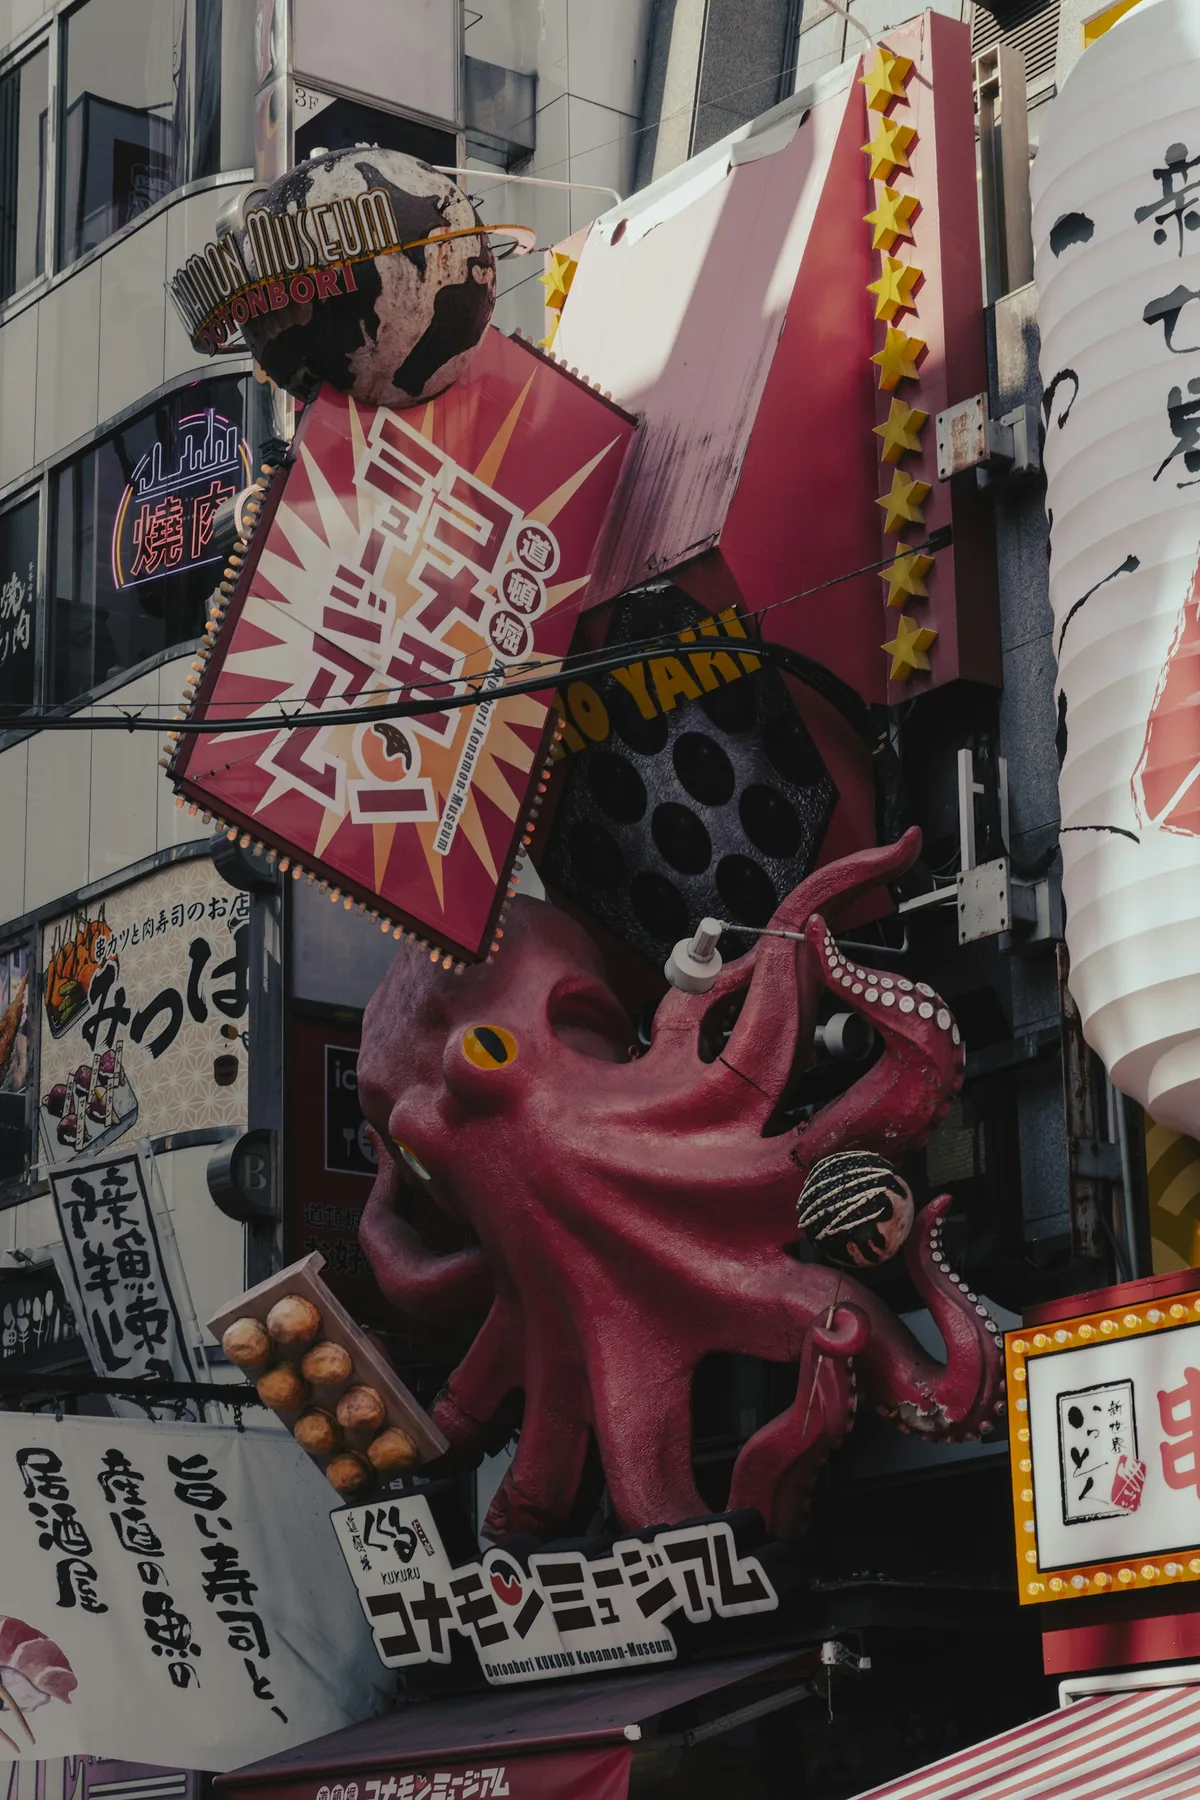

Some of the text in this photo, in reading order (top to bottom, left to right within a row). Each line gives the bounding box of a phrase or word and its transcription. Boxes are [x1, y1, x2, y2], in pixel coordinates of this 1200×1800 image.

[295, 88, 318, 109] 3F
[246, 187, 400, 278] MUSEUM
[202, 264, 358, 357] DOTONBORI
[267, 414, 448, 803] ミュージアム
[490, 528, 555, 657] 道頓堀
[352, 470, 519, 819] コナモン
[609, 608, 762, 721] YAKI
[436, 727, 485, 852] Konamon-Museum
[95, 892, 249, 961] 串カツと肉寿司のお店
[243, 1153, 267, 1190] B
[1068, 1405, 1109, 1506] いっとく
[1108, 1400, 1127, 1453] 新世界
[16, 1447, 109, 1614] 居酒屋
[381, 1567, 421, 1586] KUKURU
[167, 1453, 288, 1724] 旨い寿司と、
[365, 1533, 770, 1658] コナモンミュージアム
[484, 1638, 674, 1678] Dotonbori KUKURU Konamon-Museum
[364, 1766, 510, 1800] コナモンミュージアム
